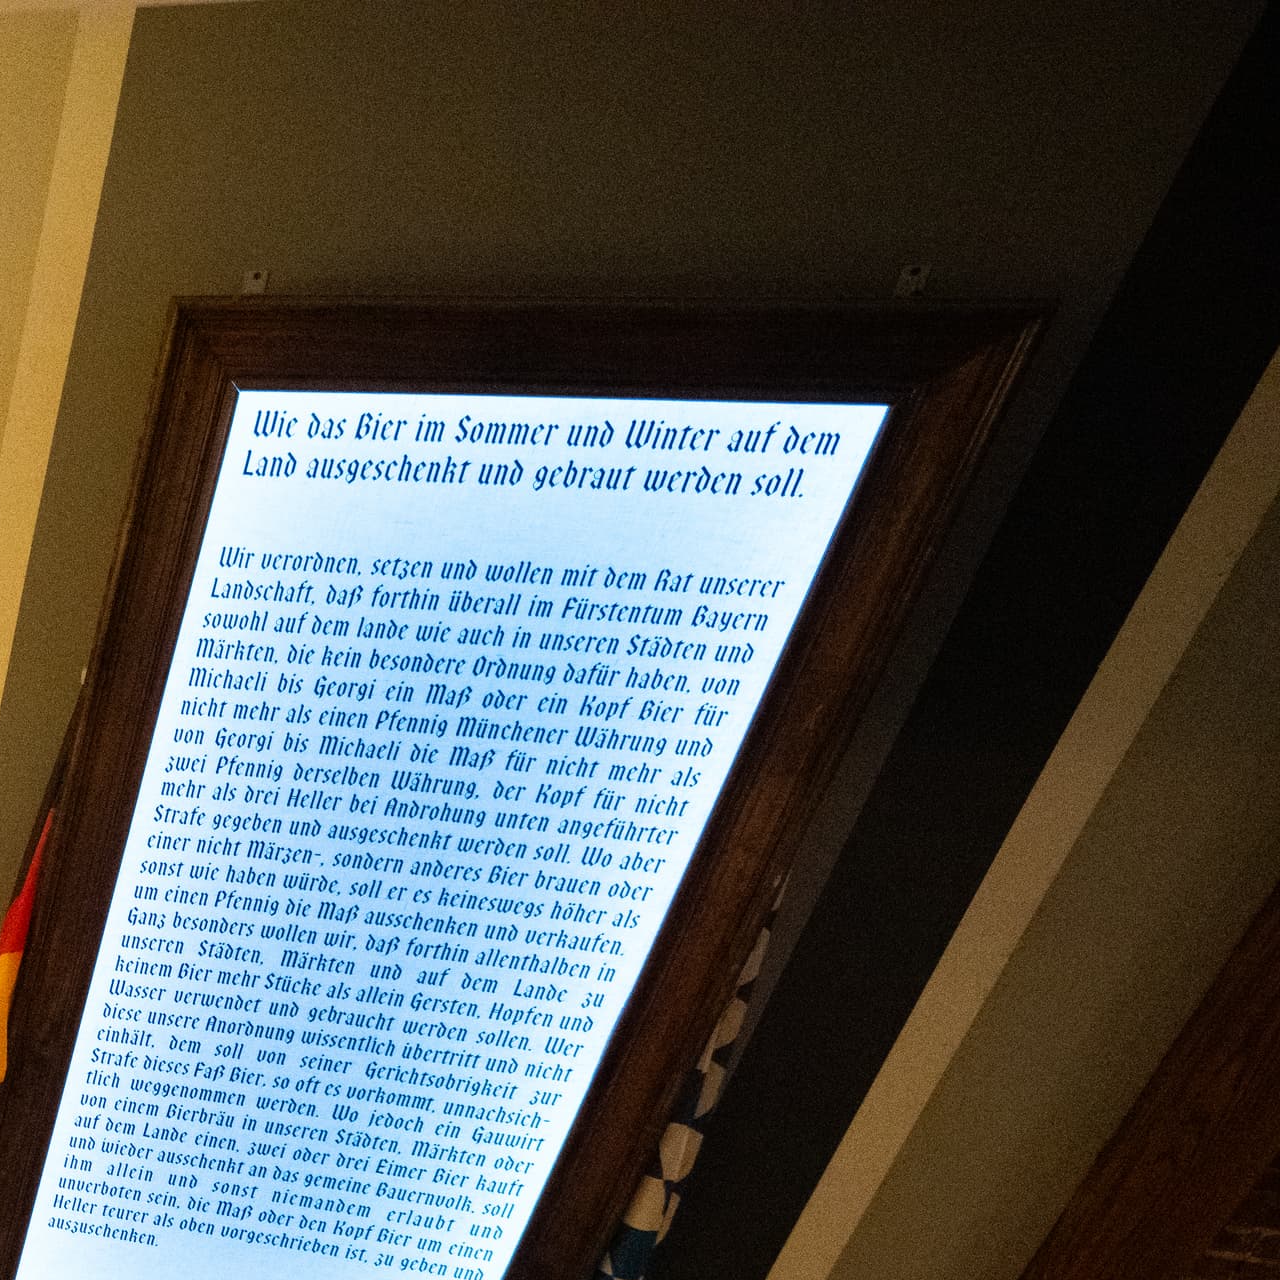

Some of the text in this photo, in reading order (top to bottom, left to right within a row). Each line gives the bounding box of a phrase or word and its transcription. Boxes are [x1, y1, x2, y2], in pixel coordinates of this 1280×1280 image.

[252, 408, 842, 457] Wie das Bier im Sommer und Winter auf dem
[241, 448, 806, 499] Land ausgeschenkt und gebraut werden soll.
[218, 545, 256, 570] Wir
[369, 556, 435, 582] setzen
[439, 558, 479, 582] und
[483, 559, 555, 586] wollen
[559, 563, 600, 589] mit
[602, 565, 648, 592] dem
[652, 567, 696, 594] Rat
[698, 575, 787, 599] unserer
[201, 609, 756, 665] sowohl auf dem lande wie auch in unseren Städten und
[324, 583, 365, 610] daß
[370, 582, 441, 613] forthin
[446, 588, 523, 617] überall
[526, 593, 555, 619] im
[559, 595, 684, 627] Fürstentum
[689, 604, 770, 634] Bayern
[179, 695, 714, 759] nicht mehr als einen Pfennig Münchener Währung und
[187, 666, 730, 728] Michaeli bis Georgi ein Maß oder ein Kopf Bier für
[172, 726, 703, 789] von Georgi bis Michaeli die Maß für nicht mehr als
[159, 778, 680, 846] mehr als drei Heller bei Androhung unten angeführter
[101, 1001, 574, 1084] diese unsere Anordnung wissentlich übertritt und nicht
[62, 1153, 504, 1241] ihm allein und sonst niemandem erlaubt und
